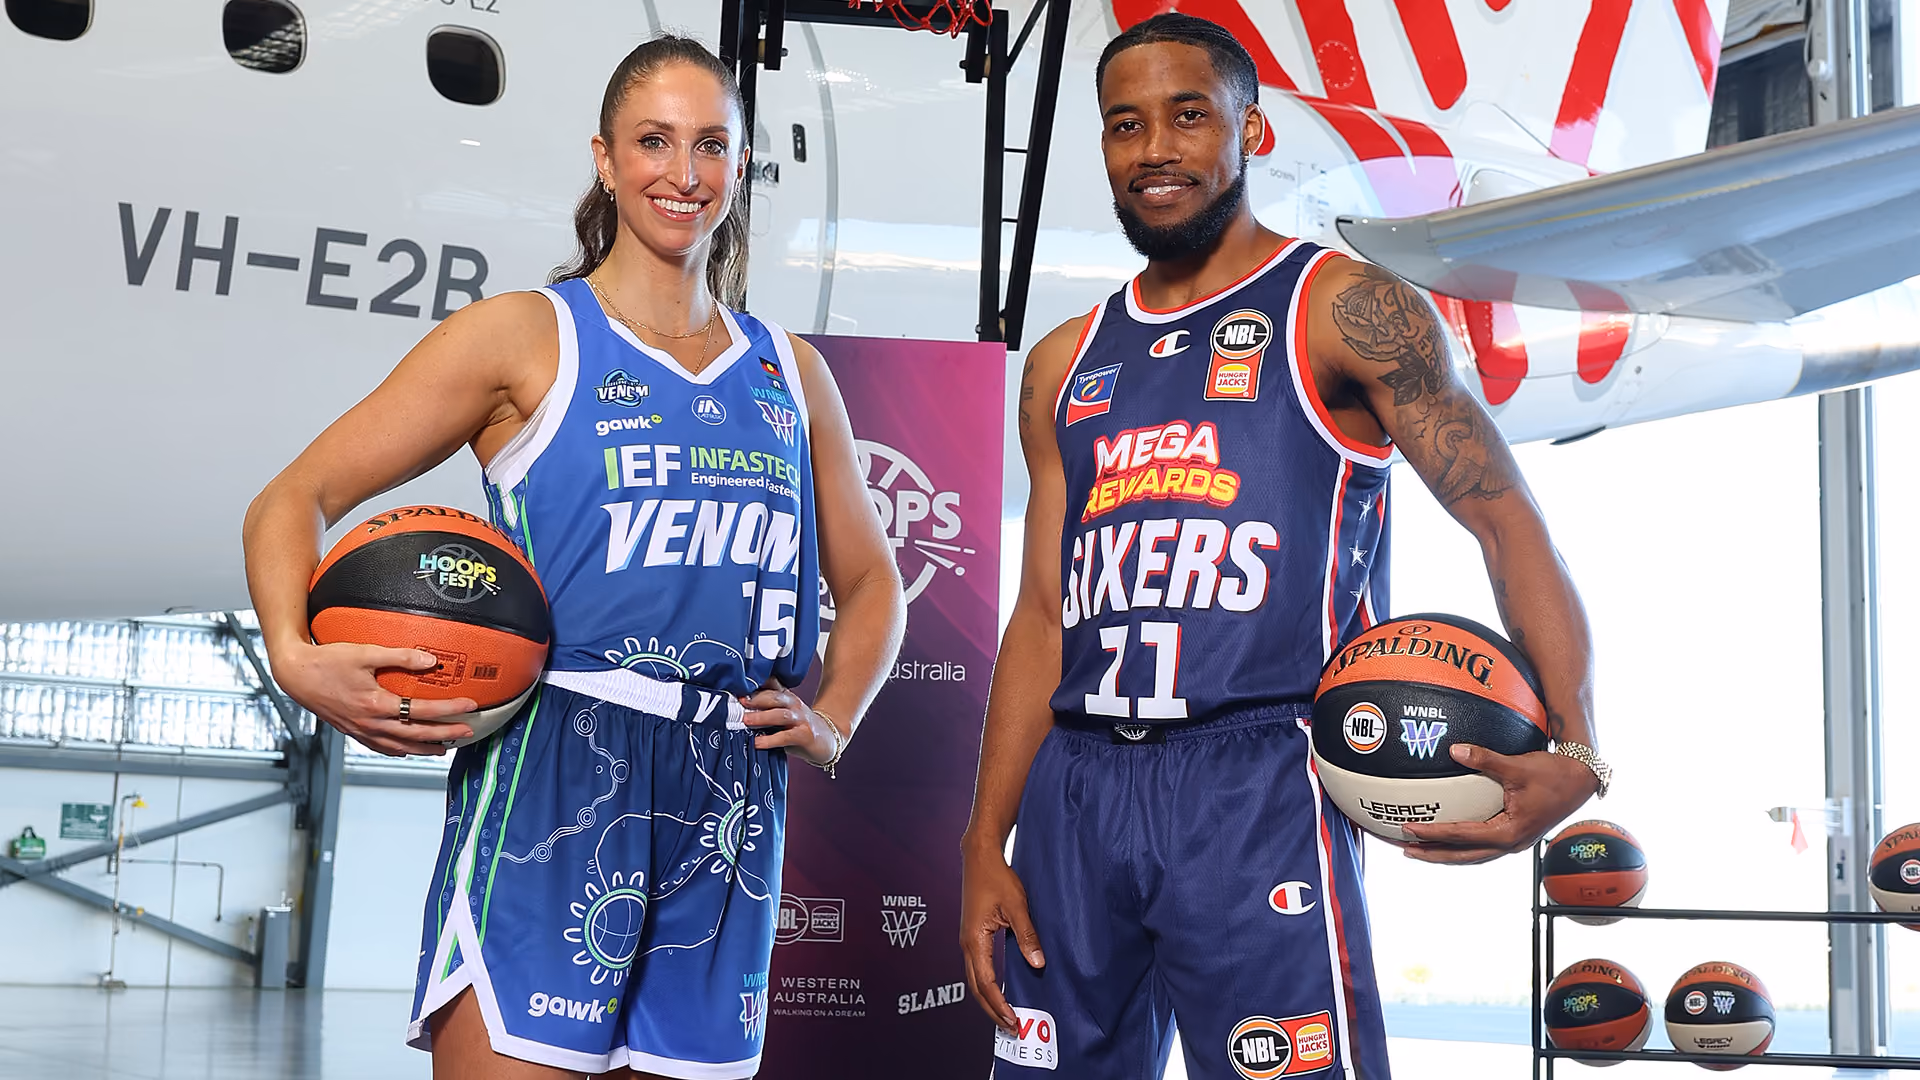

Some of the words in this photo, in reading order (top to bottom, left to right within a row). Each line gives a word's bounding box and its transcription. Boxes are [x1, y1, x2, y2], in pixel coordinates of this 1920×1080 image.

[118, 201, 489, 322] VH-E2B
[1223, 323, 1258, 346] NBL
[1078, 368, 1118, 384] Tyrepower
[1218, 371, 1248, 380] HUNGRY
[750, 385, 793, 408] WNBL
[595, 414, 653, 437] gawk
[1096, 423, 1219, 475] MEGA
[603, 443, 681, 491] IEF
[691, 471, 765, 488] Engineered
[1083, 467, 1238, 517] REWARDS
[600, 499, 801, 577] VENOM
[419, 554, 497, 583] HOOPS
[1062, 518, 1280, 629] SIXERS
[439, 571, 477, 589] FEST
[741, 580, 797, 661] 15
[887, 660, 966, 681] ustralia
[1084, 621, 1189, 719] 11
[1332, 636, 1496, 690] SPALDING
[1403, 705, 1447, 719] WNBL
[1351, 717, 1375, 738] NBL
[1359, 797, 1441, 816] LEGACY
[1570, 844, 1607, 854] HOOPS
[882, 895, 927, 908] WNBL
[781, 977, 861, 990] WESTERN
[527, 992, 607, 1024] gawk
[773, 992, 866, 1005] AUSTRALIA
[898, 981, 966, 1015] SLAND
[1563, 994, 1598, 1008] HOOPS
[773, 1009, 812, 1017] WALKING
[835, 1010, 866, 1018] DREAM
[1298, 1033, 1327, 1044] HUNGRY
[1693, 1036, 1733, 1045] LEGACY
[1241, 1036, 1280, 1064] NBL
